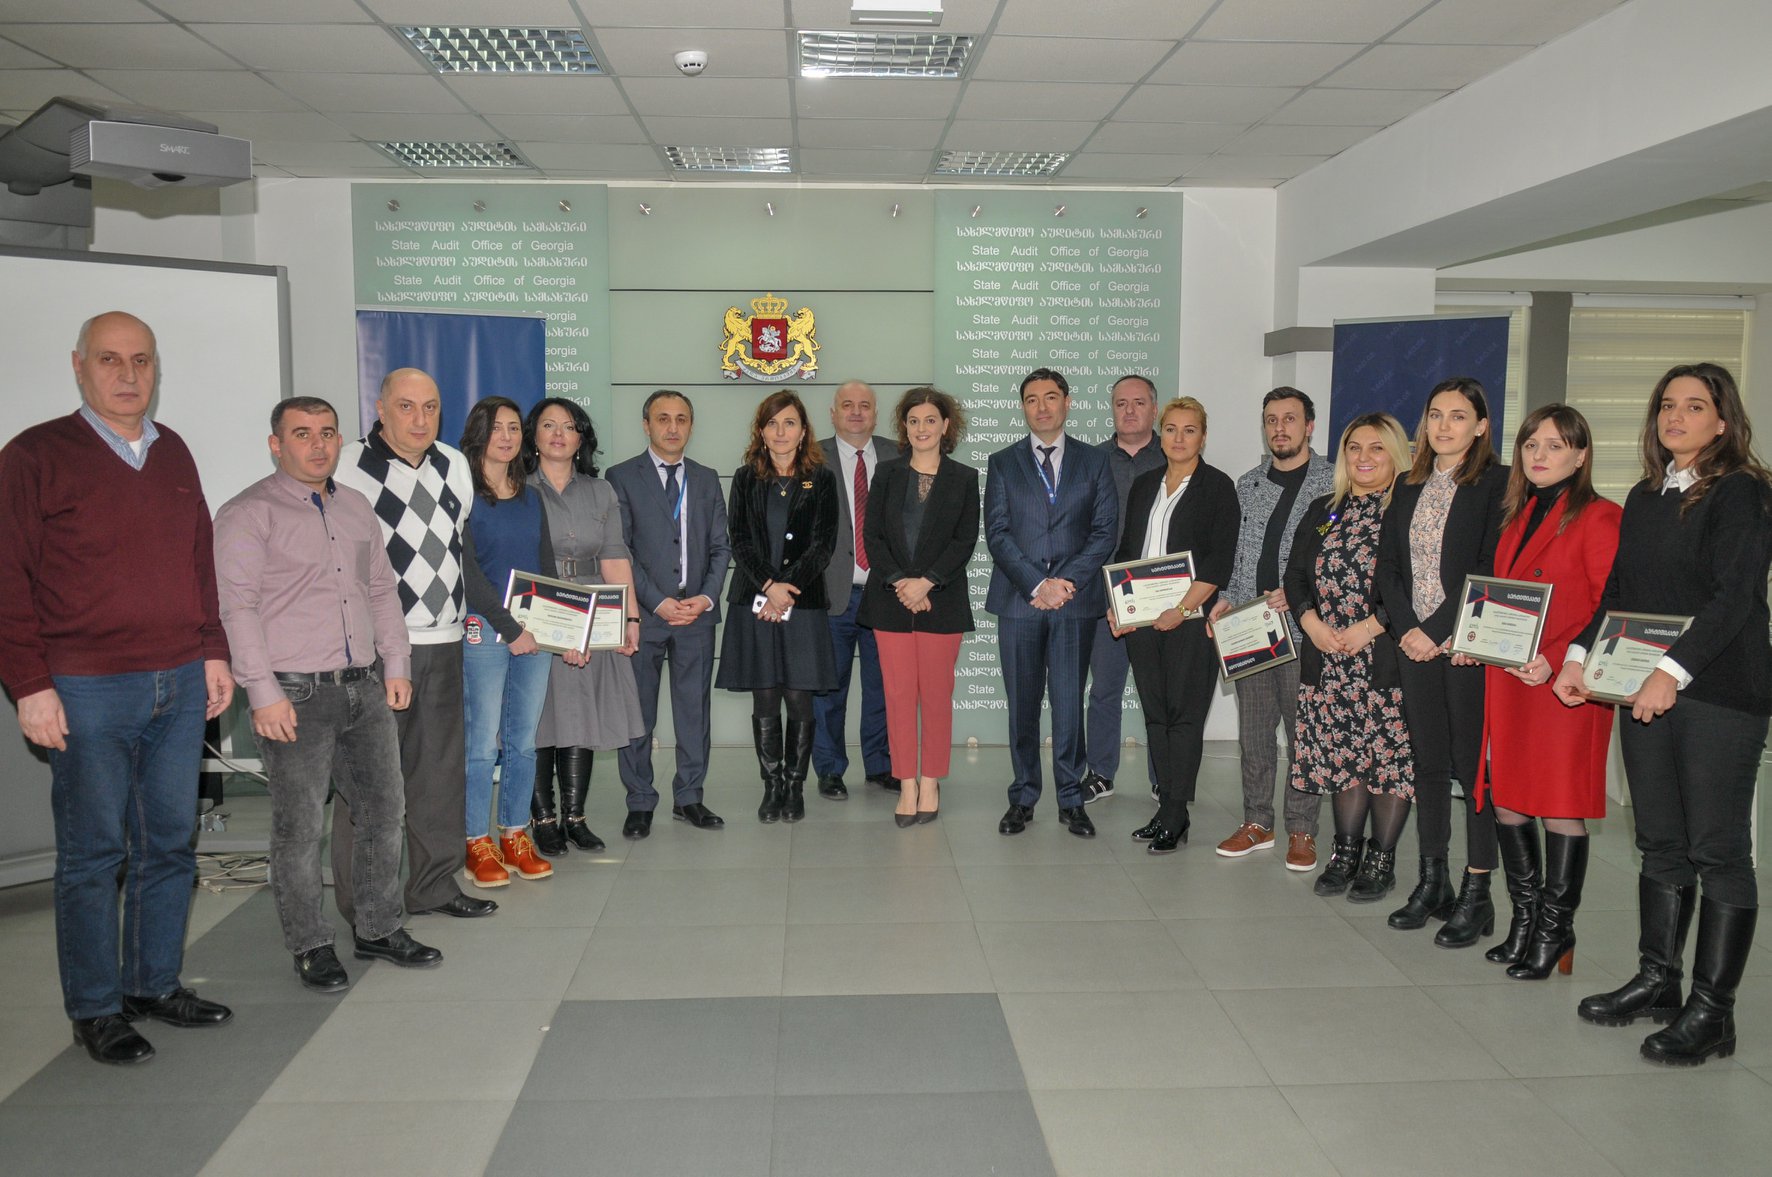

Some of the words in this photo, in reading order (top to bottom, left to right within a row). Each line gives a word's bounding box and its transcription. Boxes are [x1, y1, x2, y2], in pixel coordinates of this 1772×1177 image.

[375, 220, 455, 232] სახელმწიფო
[460, 220, 517, 232] აუდიტის
[522, 221, 587, 233] სამსახური
[955, 226, 1035, 238] სახელმწიფო
[1040, 227, 1095, 239] აუდიტის
[1100, 228, 1163, 240] სამსახური
[391, 239, 420, 251] State
[431, 239, 460, 251] Audit
[471, 239, 503, 251] Office
[511, 240, 523, 251] of
[530, 240, 574, 253] Georgia
[972, 244, 1000, 257] State
[1010, 245, 1039, 257] Audit
[1049, 245, 1081, 257] Office
[1088, 246, 1100, 257] of
[1107, 246, 1149, 260] Georgia
[376, 256, 456, 267] სახელმწიფო
[461, 256, 519, 268] აუდიტის
[523, 256, 588, 268] სამსახური
[956, 260, 1035, 273] სახელმწიფო
[1039, 261, 1095, 273] აუდიტის
[1099, 261, 1162, 274] სამსახური
[393, 274, 423, 286] State
[433, 274, 462, 286] Audit
[473, 274, 506, 286] Office
[513, 275, 525, 286] of
[532, 275, 576, 288] Georgia
[973, 279, 1001, 290] State
[1011, 280, 1039, 291] Audit
[1050, 280, 1081, 291] Office
[1089, 280, 1101, 291] of
[1107, 281, 1150, 294] Georgia
[377, 291, 457, 302] სახელმწიფო
[462, 291, 519, 303] აუდიტის
[524, 291, 589, 303] სამსახური
[956, 295, 1034, 307] სახელმწიფო
[1039, 296, 1094, 308] აუდიტის
[1098, 297, 1161, 308] სამსახური
[972, 314, 1001, 325] State
[1011, 314, 1039, 325] Audit
[1049, 314, 1081, 326] Office
[1088, 314, 1100, 326] of
[1107, 315, 1149, 329] Georgia
[955, 330, 1034, 341] სახელმწიფო
[1038, 331, 1093, 342] აუდიტის
[1098, 329, 1161, 342] სამსახური
[545, 346, 577, 358] eorgia
[972, 348, 1000, 359] State
[1010, 348, 1038, 360] Audit
[1049, 348, 1080, 360] Office
[1088, 349, 1099, 360] of
[1106, 349, 1148, 362] Georgia
[955, 364, 1033, 376] სახელმწიფო
[1097, 365, 1160, 377] სამსახური
[545, 381, 578, 393] eorgia
[971, 382, 1000, 393] State
[1087, 383, 1099, 394] of
[971, 416, 999, 427] State
[1086, 417, 1097, 428] of
[968, 651, 996, 662] State
[967, 684, 995, 694] State
